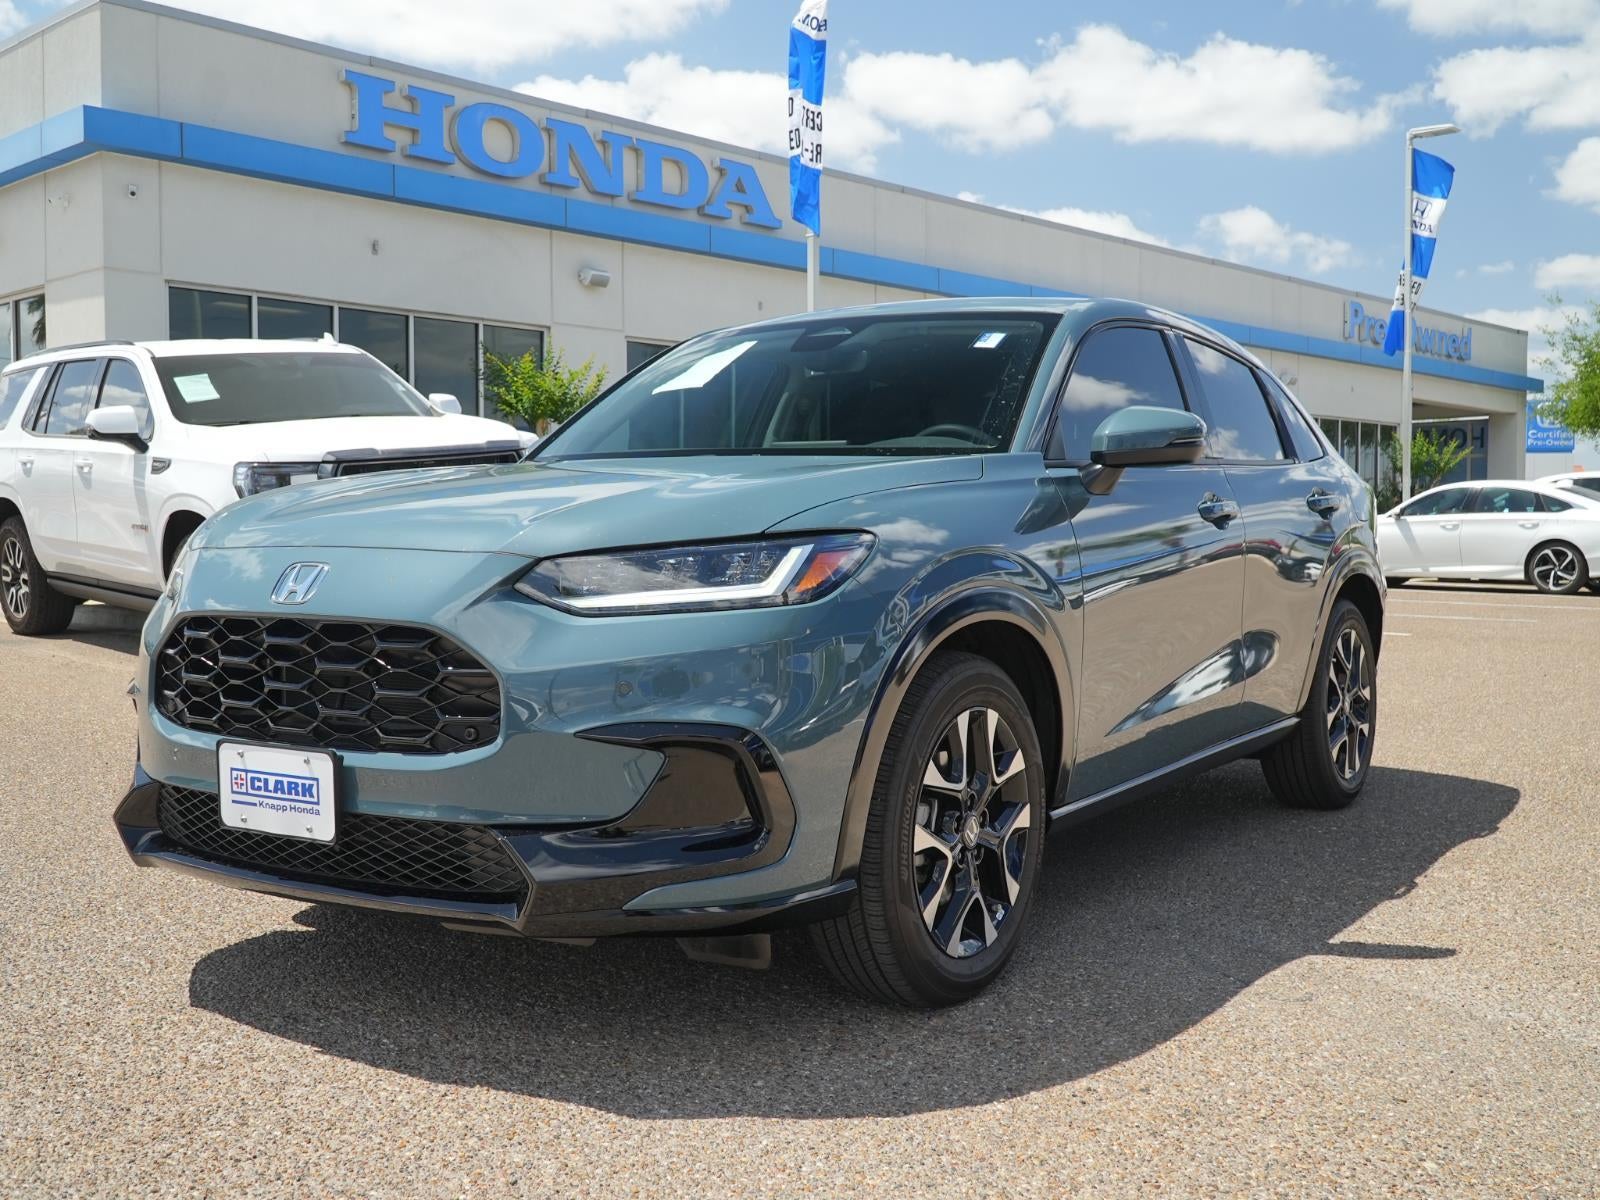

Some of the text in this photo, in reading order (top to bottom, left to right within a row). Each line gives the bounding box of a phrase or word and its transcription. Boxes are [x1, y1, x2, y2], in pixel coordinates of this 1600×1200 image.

[343, 69, 782, 229] HONDA
[1411, 219, 1432, 233] NDA
[249, 775, 315, 799] CLARK
[258, 800, 321, 816] Knapp Honda
